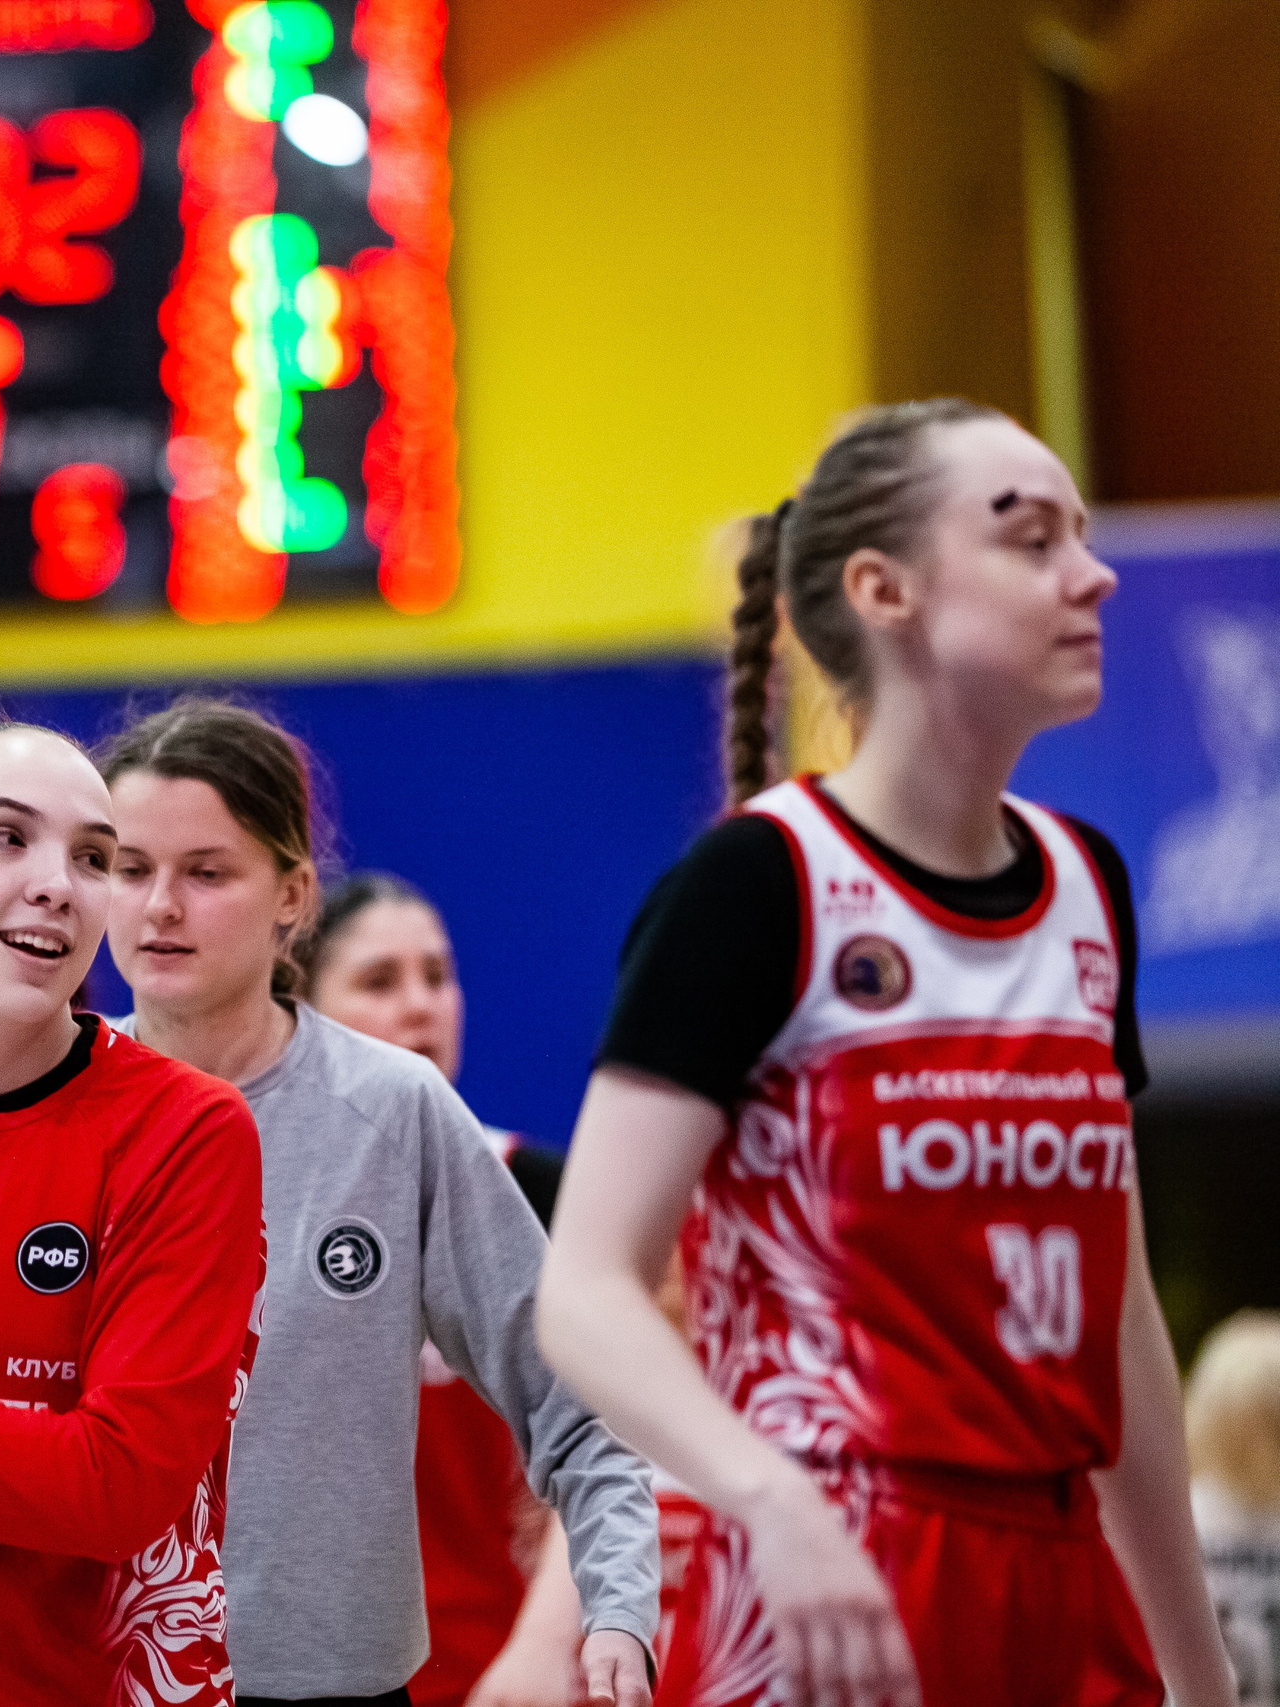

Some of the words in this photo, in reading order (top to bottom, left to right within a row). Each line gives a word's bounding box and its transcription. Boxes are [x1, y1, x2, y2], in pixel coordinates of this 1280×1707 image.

[27, 1246, 79, 1268] РФБ
[984, 1221, 1084, 1363] 30
[6, 1356, 76, 1380] КЛУБ
